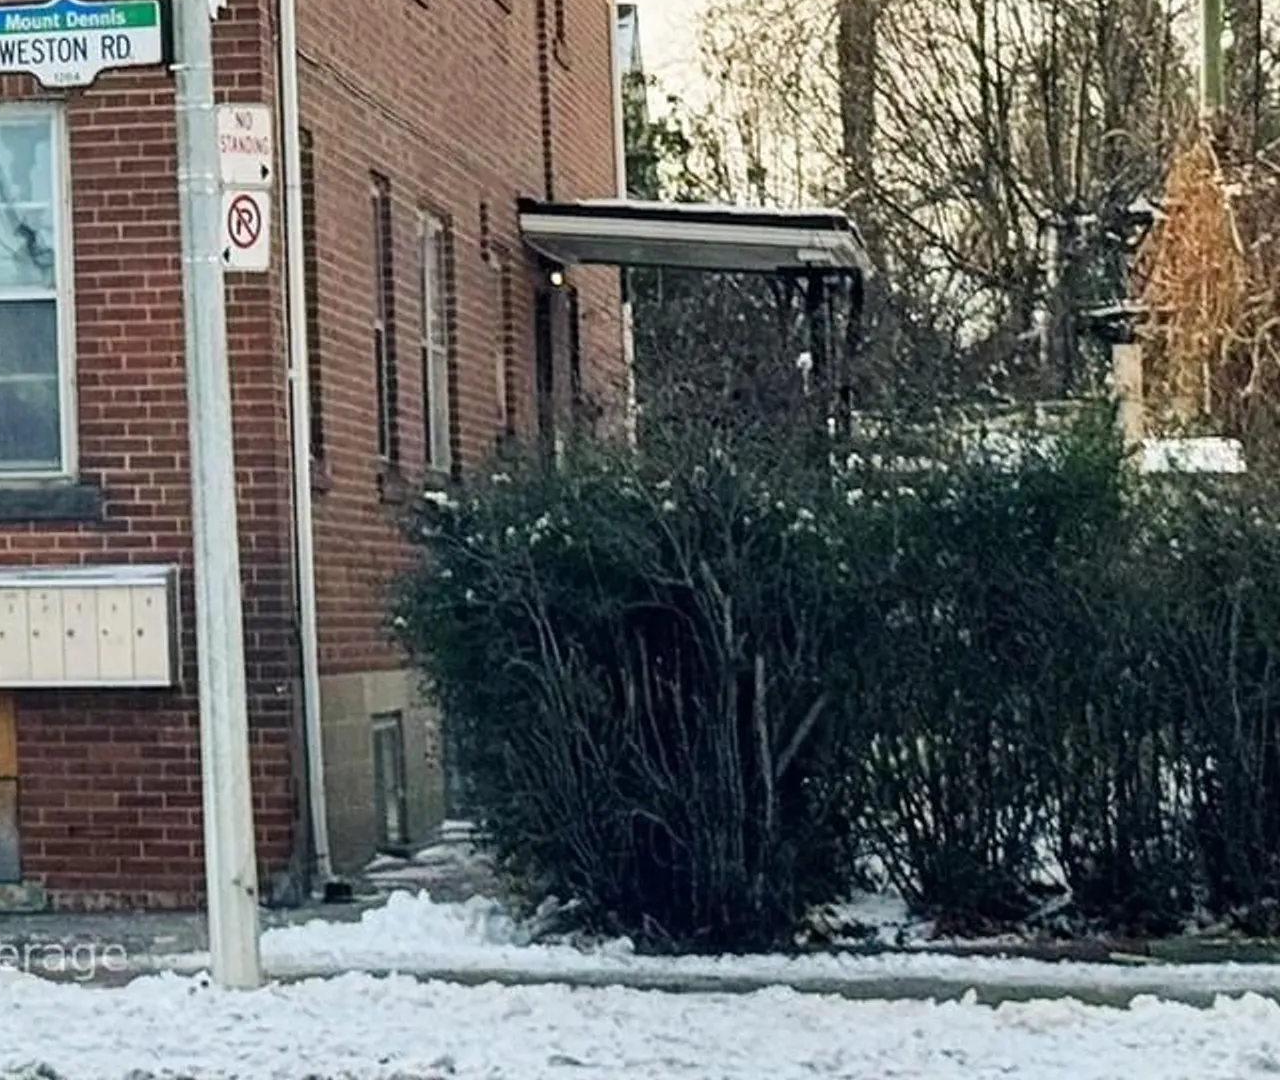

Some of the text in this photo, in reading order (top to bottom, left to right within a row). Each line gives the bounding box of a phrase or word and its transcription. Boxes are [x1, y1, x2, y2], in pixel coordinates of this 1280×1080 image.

[4, 8, 126, 32] Mount Dennis
[101, 34, 131, 60] RD
[235, 111, 253, 131] NO
[220, 134, 270, 156] STANDING
